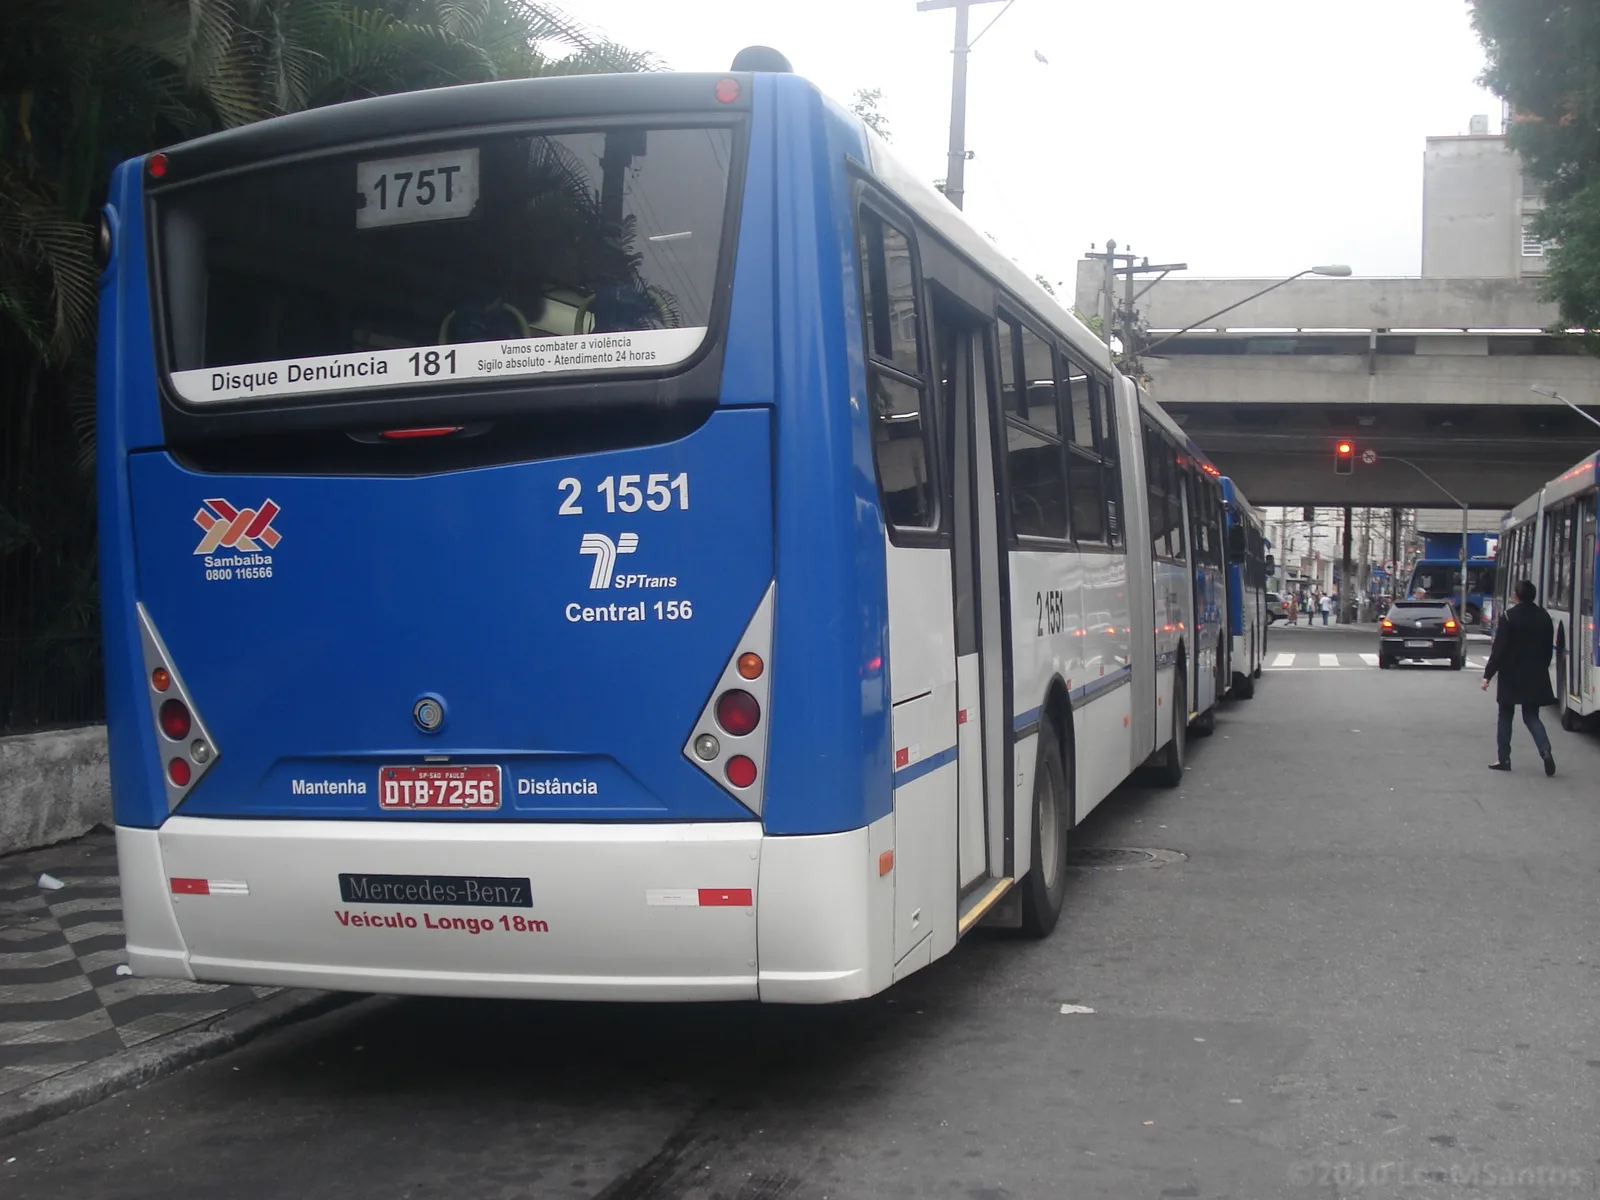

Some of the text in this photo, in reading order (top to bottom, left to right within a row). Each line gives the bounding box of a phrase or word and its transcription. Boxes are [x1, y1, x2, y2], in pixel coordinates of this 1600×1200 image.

[372, 165, 461, 210] 175T
[501, 337, 631, 355] Vamos combater a violência
[212, 349, 456, 392] Disque Denúncia 181
[478, 358, 502, 372] Sigilo
[506, 357, 545, 368] absoluto
[554, 352, 613, 365] Atendimento
[616, 350, 626, 361] 24
[629, 350, 656, 360] horas
[558, 472, 689, 515] 2 1551
[204, 554, 272, 567] Sambaiba
[206, 567, 273, 580] 0800 116566
[615, 574, 677, 589] SPTrans
[565, 601, 692, 622] Central 156
[1036, 590, 1064, 636] 2 1551
[292, 780, 367, 795] Mantenha
[517, 778, 598, 795] Distância
[349, 877, 523, 904] Mercedes-Benz
[424, 913, 494, 935] Longo
[499, 915, 549, 933] 18m
